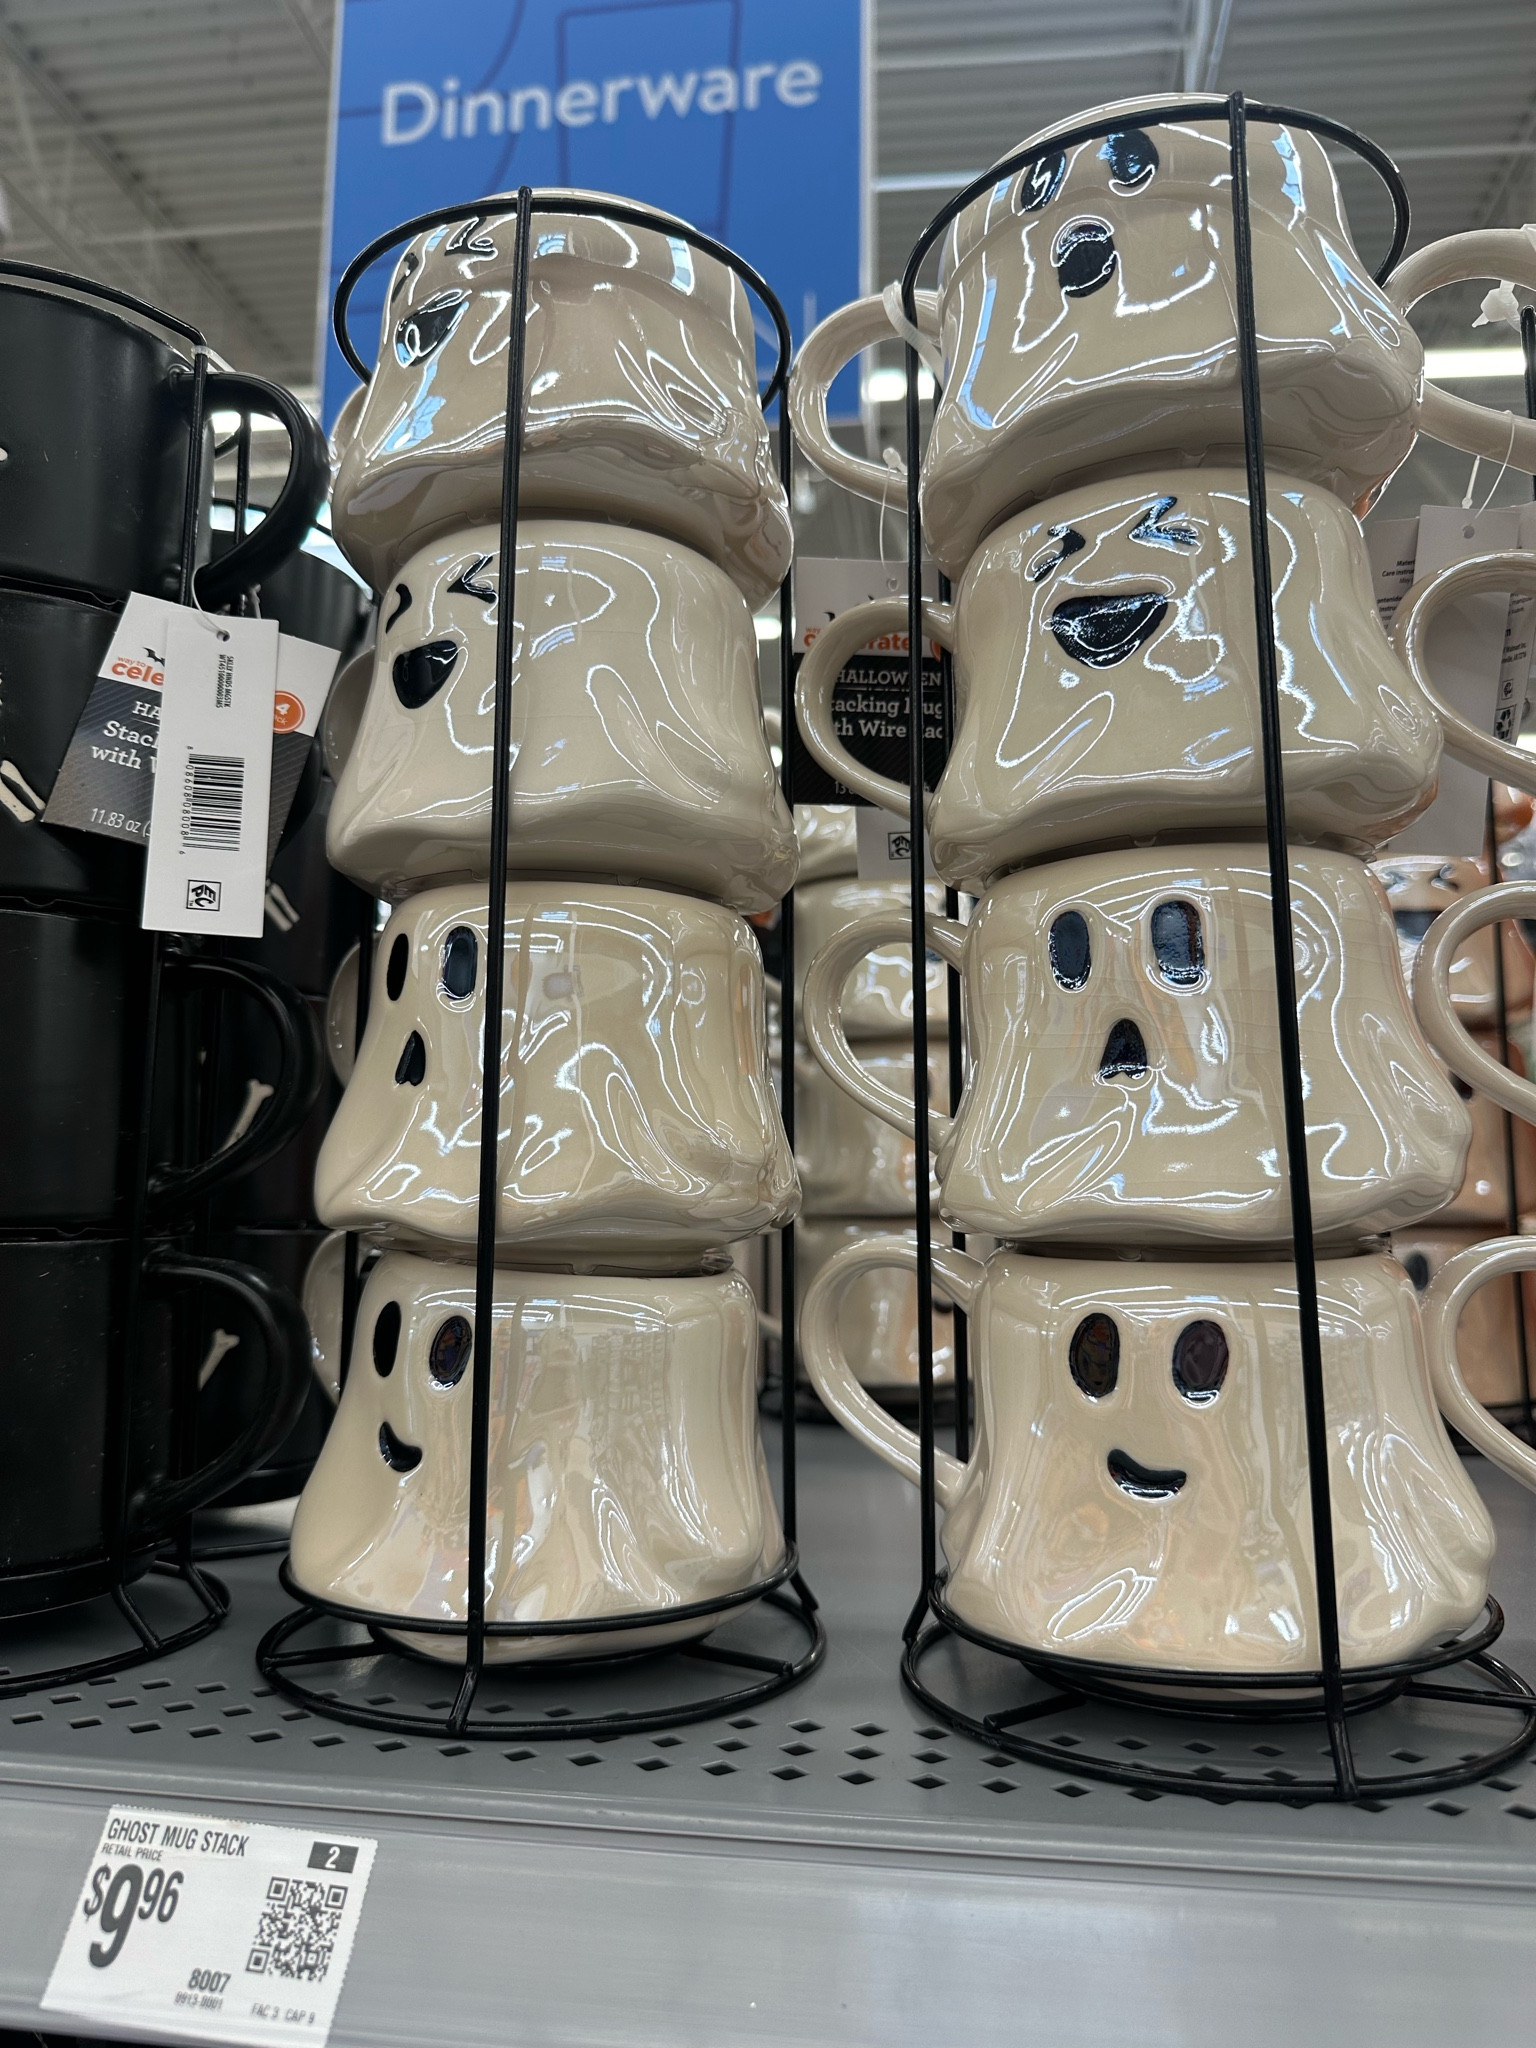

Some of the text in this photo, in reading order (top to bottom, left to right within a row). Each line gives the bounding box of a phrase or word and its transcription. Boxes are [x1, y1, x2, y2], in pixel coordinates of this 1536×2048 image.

[379, 60, 822, 146] Dinnerware
[117, 656, 147, 668] way to
[836, 670, 942, 687] HALLOWEN
[858, 719, 907, 738] Wire
[91, 745, 142, 770] with
[91, 807, 125, 829] 11.83
[125, 820, 142, 834] oz
[107, 1817, 250, 1857] GHOST MUG STACK
[101, 1842, 165, 1862] RETAIL PRICE
[324, 1845, 341, 1869] 2
[187, 1967, 232, 1993] 8007
[251, 2002, 271, 2017] FAC
[271, 2005, 280, 2018] 3
[285, 2008, 306, 2023] CAP
